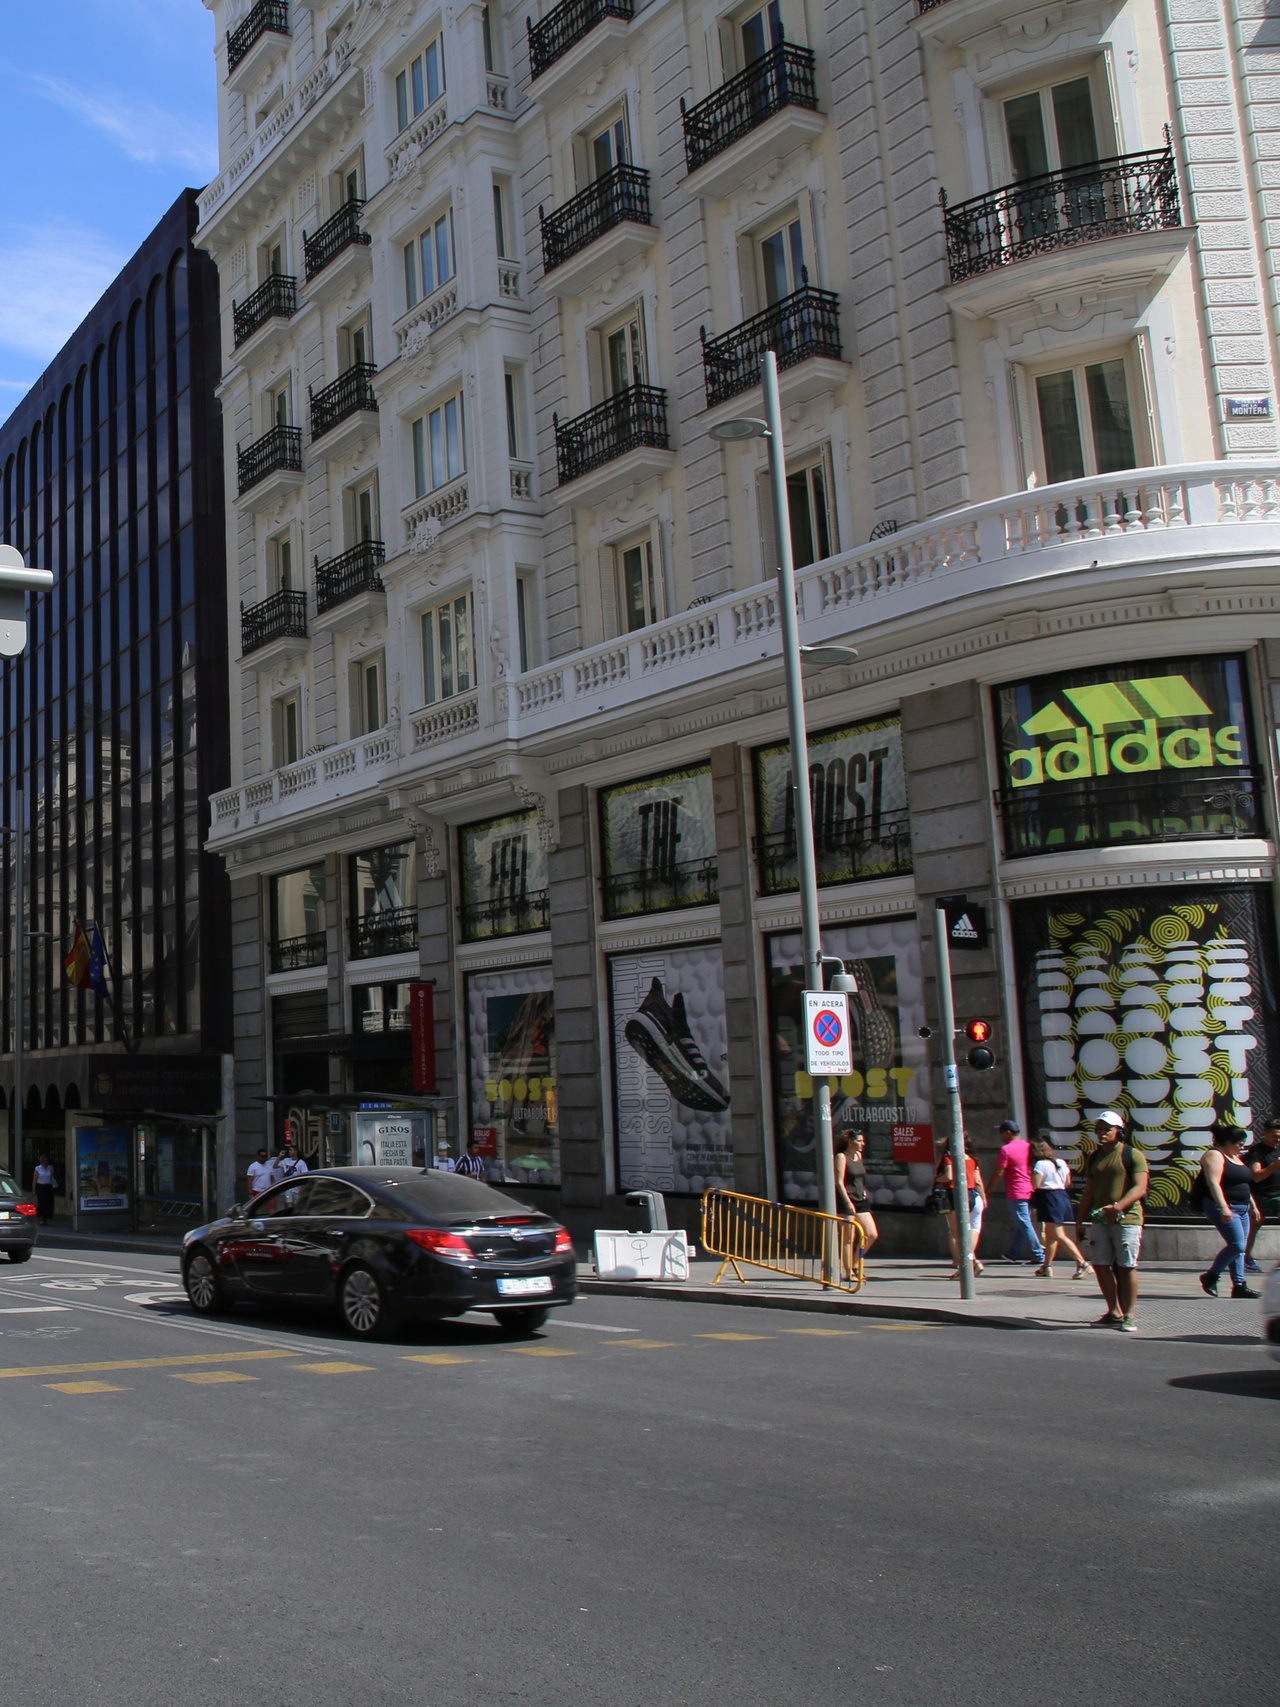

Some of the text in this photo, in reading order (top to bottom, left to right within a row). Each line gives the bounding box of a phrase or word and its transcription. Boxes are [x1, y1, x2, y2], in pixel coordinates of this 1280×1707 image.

[1232, 407, 1268, 415] MONTERA
[1009, 718, 1243, 788] adidas
[639, 796, 683, 884] THE
[952, 928, 978, 938] adidas
[485, 1077, 557, 1102] BOOST
[513, 1106, 550, 1120] ULTRABOOST
[842, 1106, 917, 1122] ULTRABOOST 19
[378, 1126, 410, 1134] GINOS
[893, 1127, 914, 1136] SALES
[395, 1140, 407, 1148] ESTÁ
[393, 1158, 407, 1166] PASTA
